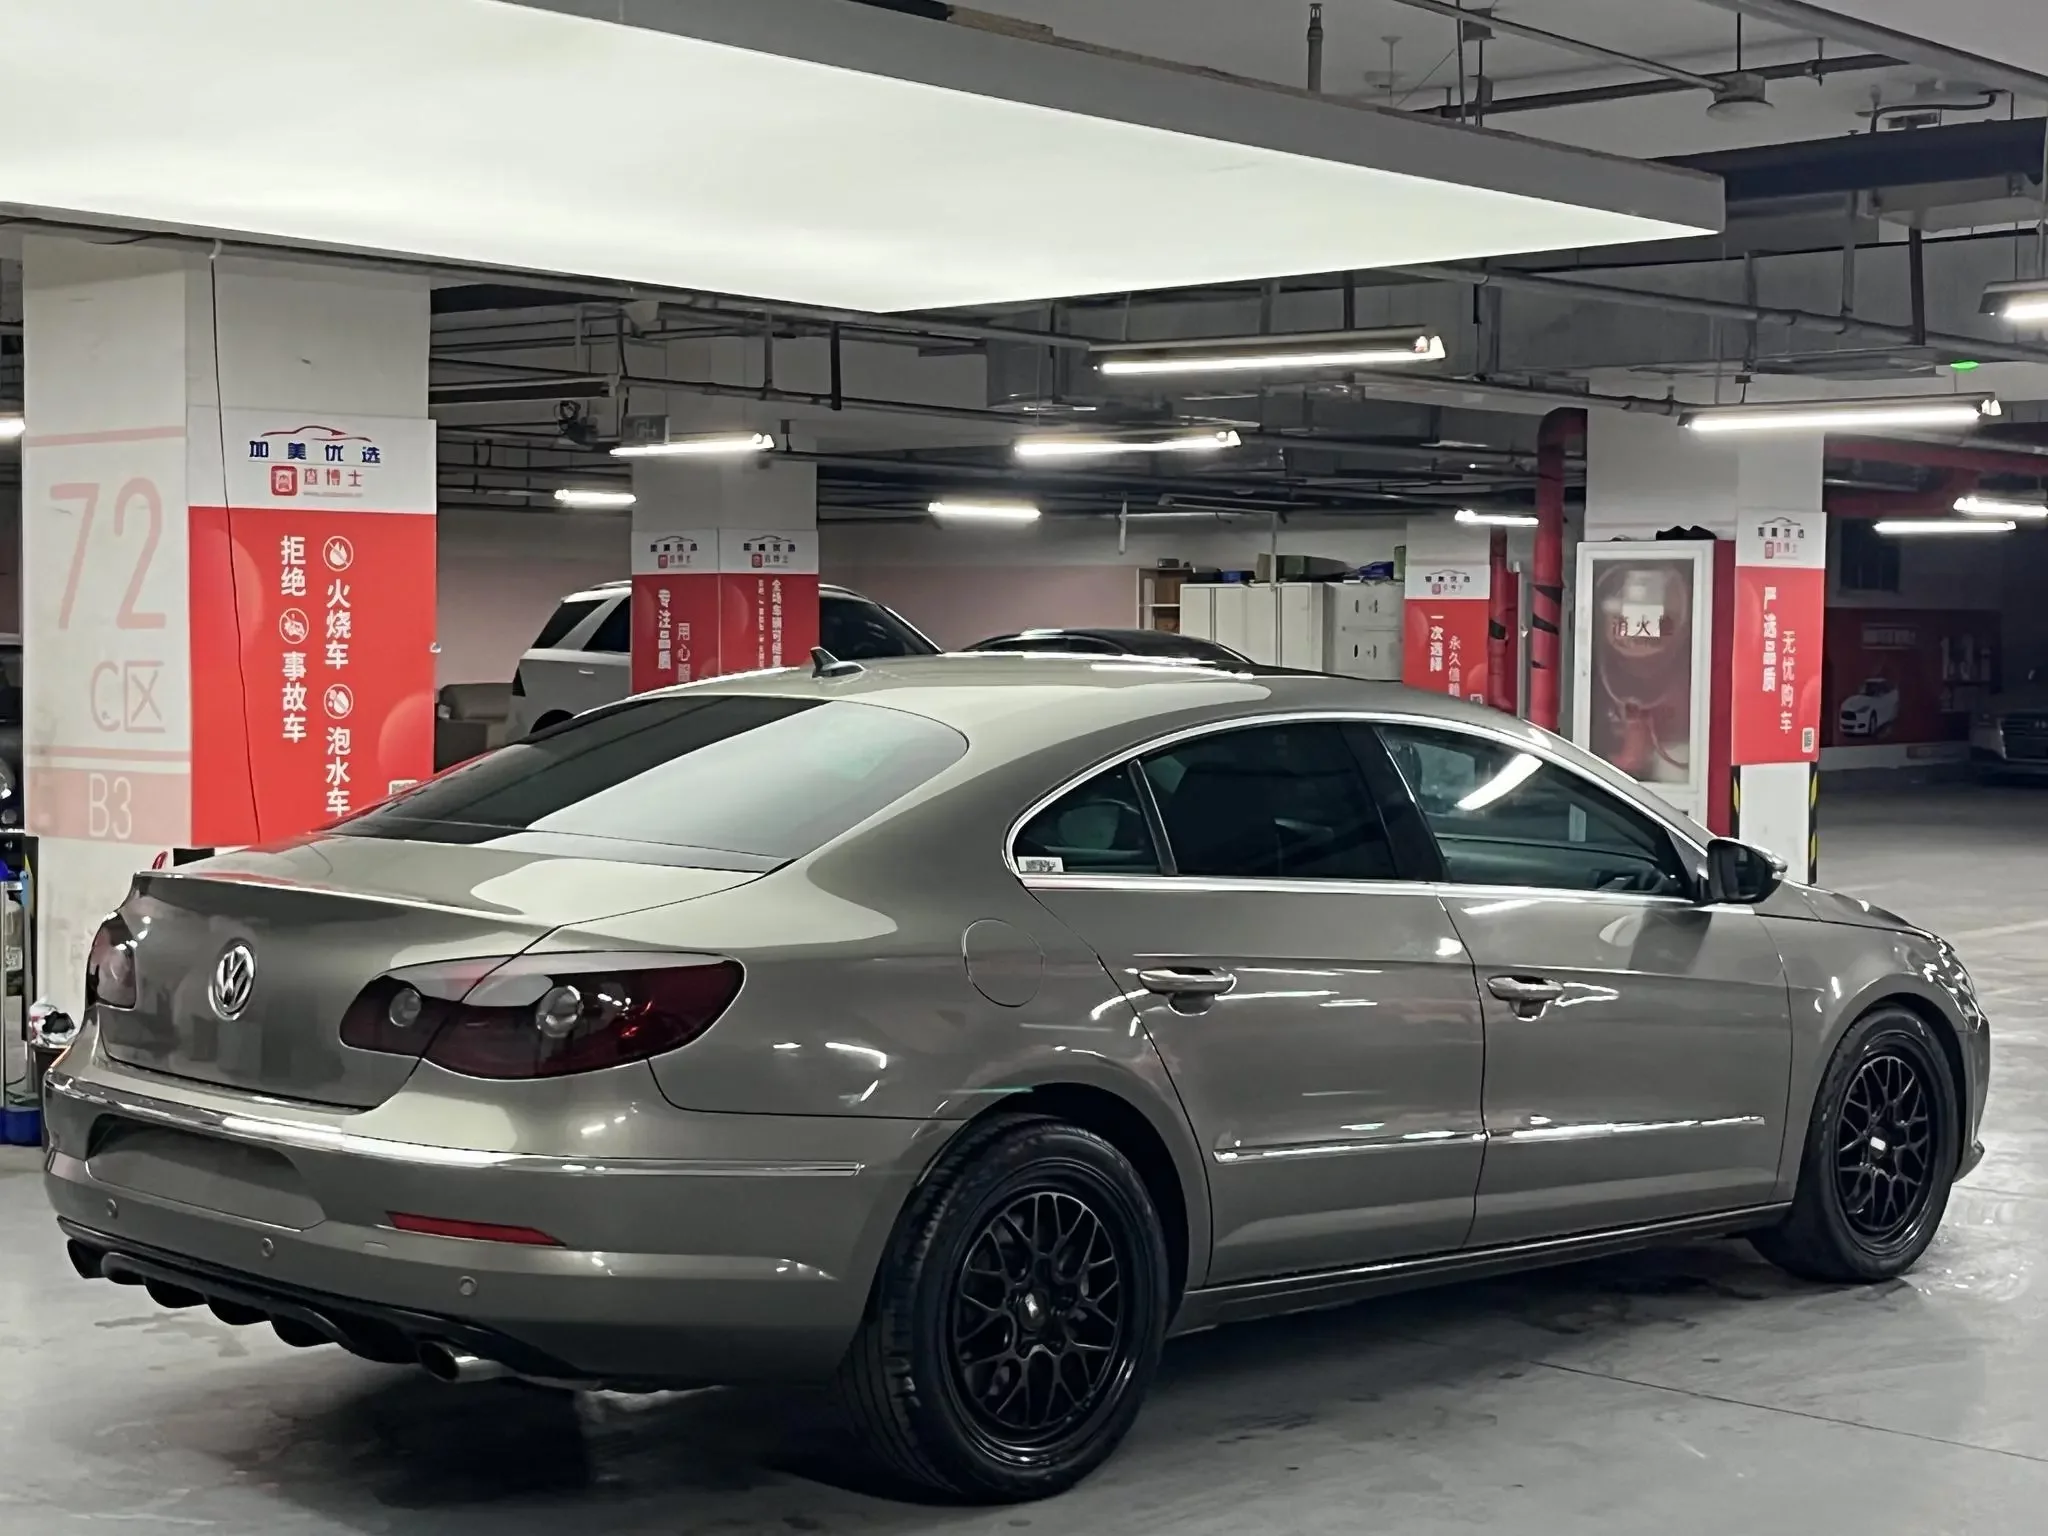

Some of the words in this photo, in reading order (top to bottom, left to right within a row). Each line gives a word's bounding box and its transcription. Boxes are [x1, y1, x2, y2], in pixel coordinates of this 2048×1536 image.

[249, 440, 381, 463] 加美优选
[50, 477, 166, 630] 72
[280, 535, 306, 597] 拒绝
[325, 579, 351, 670] 火烧车
[1762, 587, 1776, 692] 严选品质
[90, 660, 166, 733] C区
[282, 651, 307, 743] 事故车
[89, 773, 133, 839] B3
[325, 727, 351, 817] 泡水车
